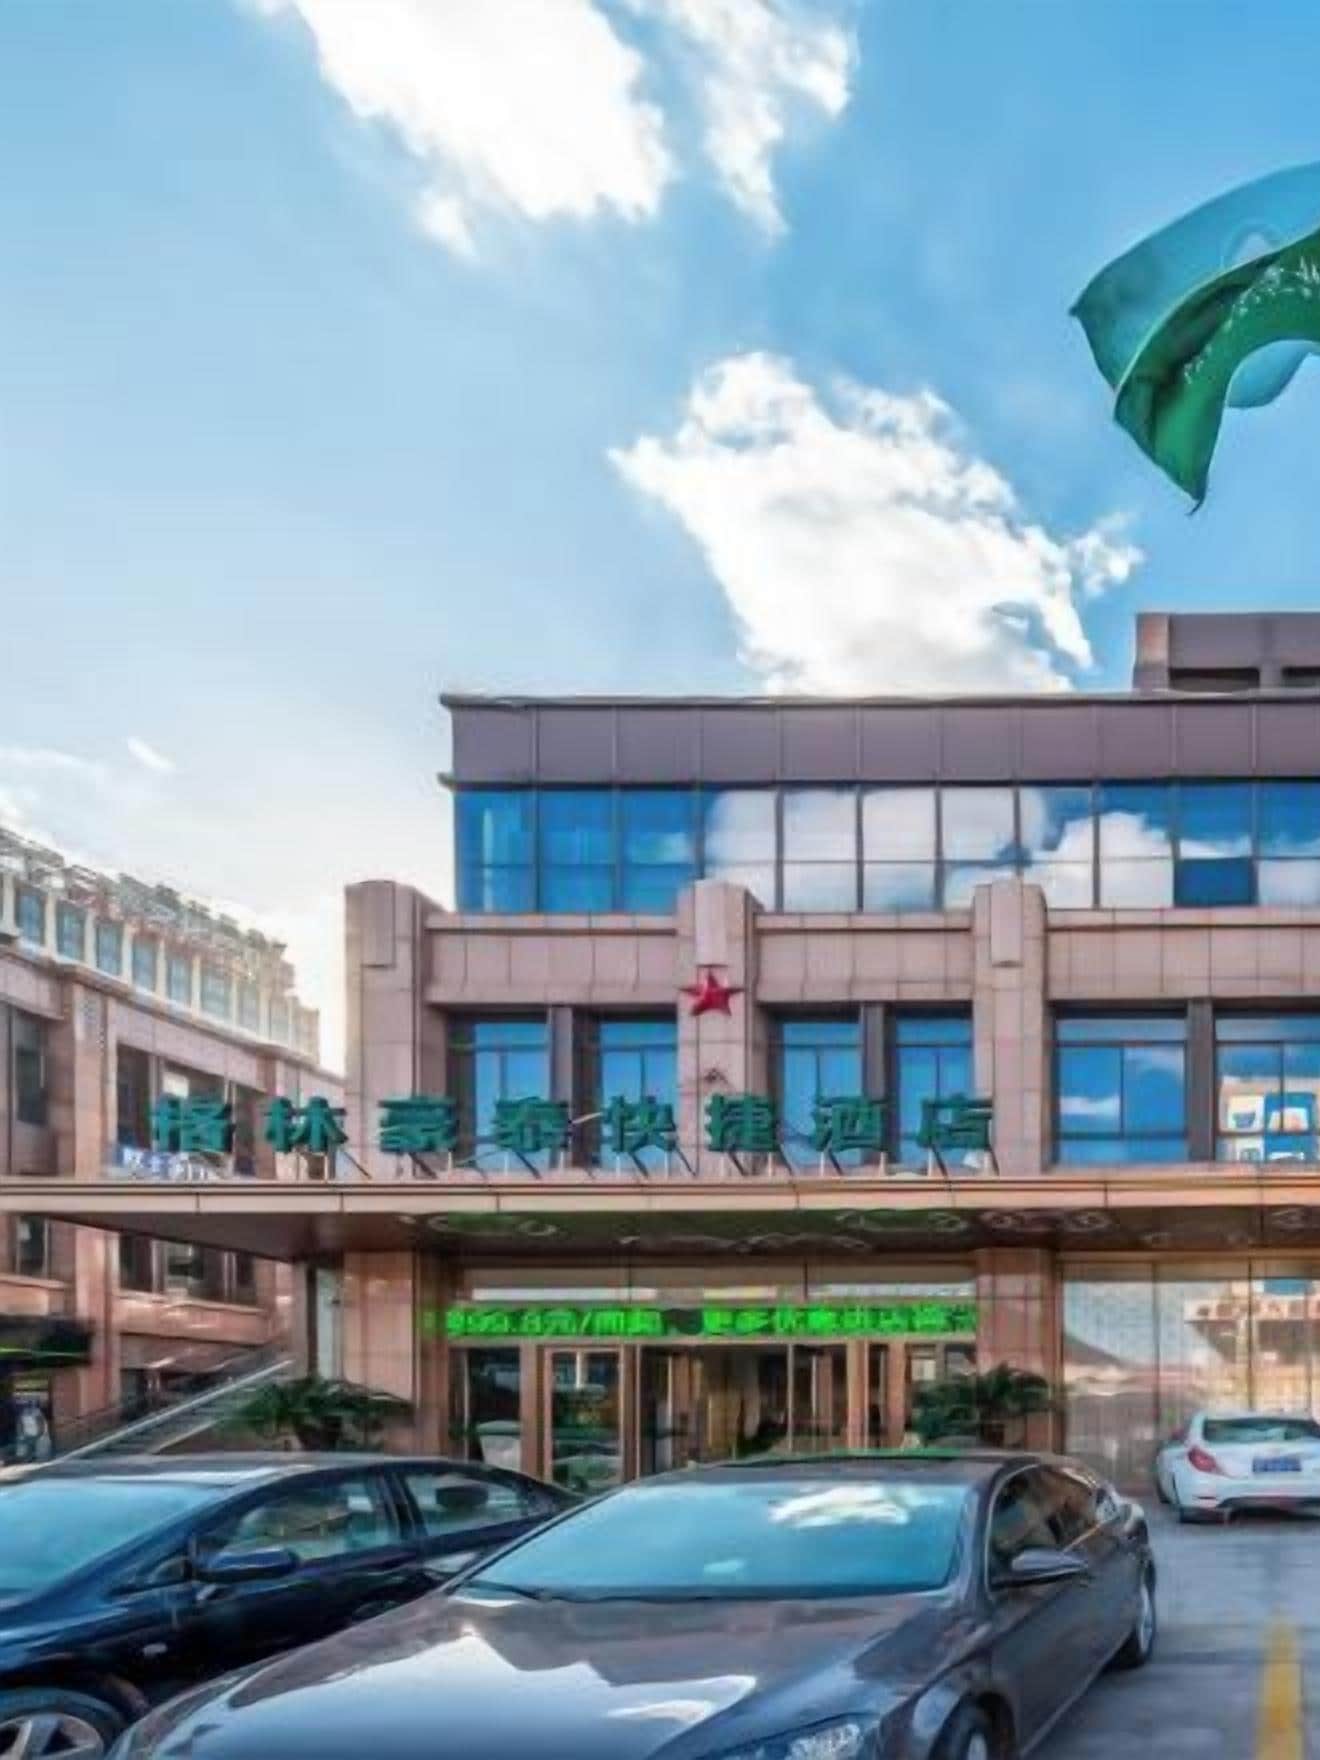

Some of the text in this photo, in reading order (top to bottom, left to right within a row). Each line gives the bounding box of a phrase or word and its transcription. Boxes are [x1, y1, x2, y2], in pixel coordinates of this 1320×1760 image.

[150, 1094, 996, 1154] 格林豪泰快捷酒店
